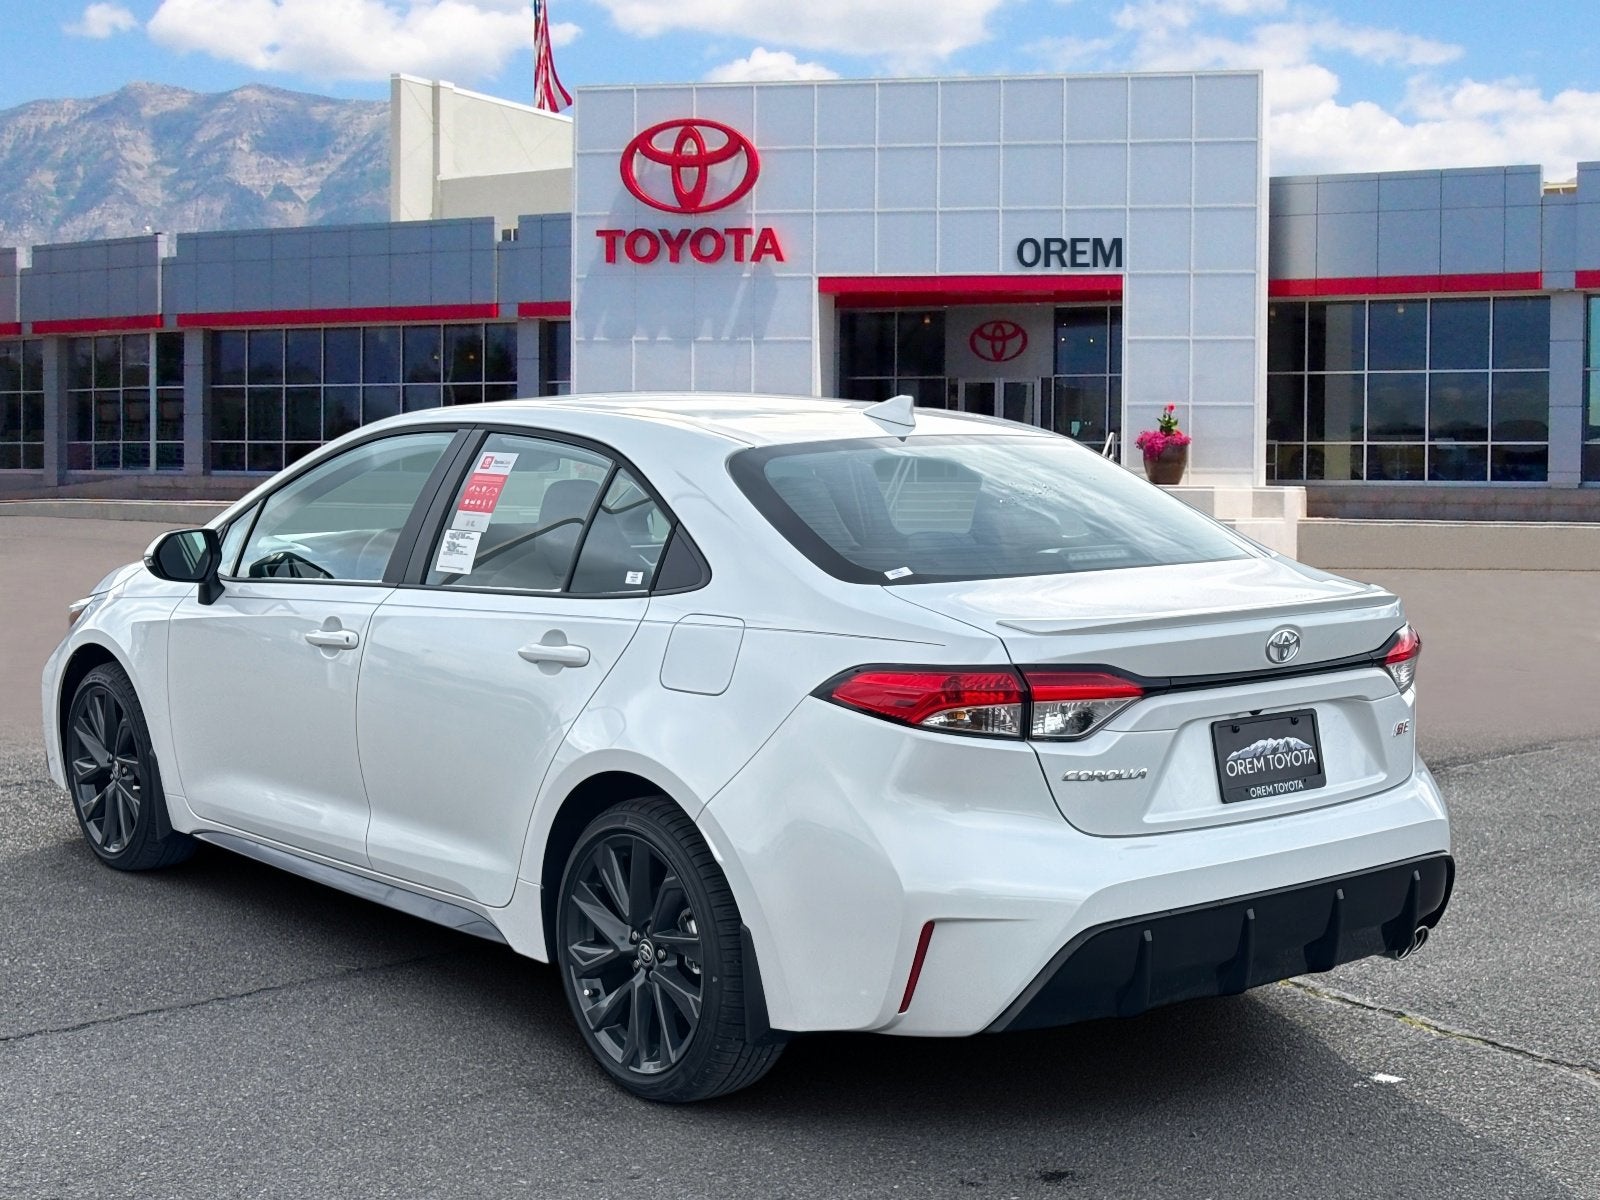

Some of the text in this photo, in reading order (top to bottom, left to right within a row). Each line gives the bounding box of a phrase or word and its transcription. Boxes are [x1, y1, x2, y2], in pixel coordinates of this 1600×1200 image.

[596, 227, 785, 264] TOYOTA
[1017, 237, 1123, 267] OREM
[1061, 767, 1148, 782] COROLLA
[1226, 748, 1317, 777] OREM TOYOTA
[1249, 779, 1305, 798] OREM TOYOTA
